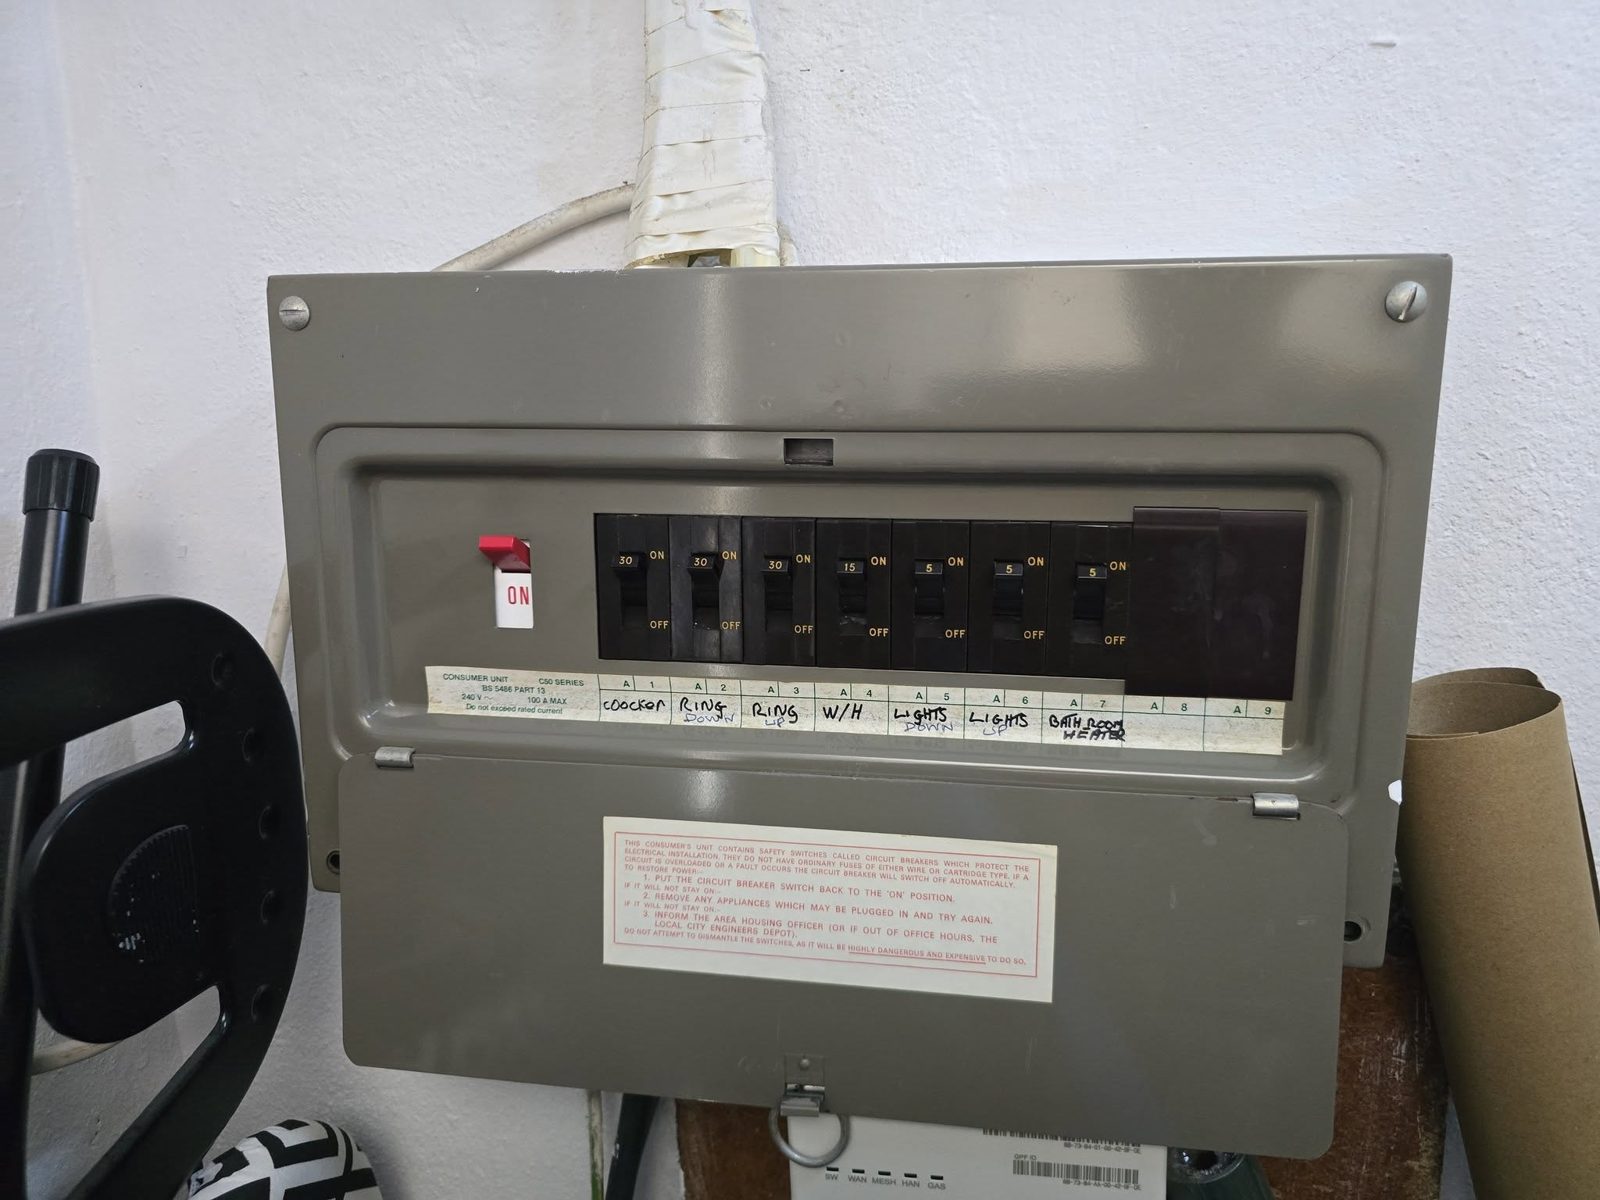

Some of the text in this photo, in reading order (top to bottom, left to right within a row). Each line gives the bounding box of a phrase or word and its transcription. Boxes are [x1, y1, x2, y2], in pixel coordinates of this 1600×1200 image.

[619, 556, 632, 564] 30
[650, 550, 664, 560] ON
[722, 551, 737, 560] ON
[796, 554, 811, 563] ON
[694, 557, 708, 567] 30
[768, 560, 782, 570] 30
[871, 556, 886, 566] ON
[948, 557, 964, 566] ON
[1028, 557, 1044, 566] ON
[1110, 562, 1126, 570] ON
[844, 563, 856, 572] 15
[926, 564, 932, 572] 5
[1006, 565, 1012, 574] 5
[1090, 568, 1096, 577] 5
[508, 586, 529, 604] ON
[650, 620, 668, 629] OFF
[722, 621, 740, 630] OFF
[794, 625, 814, 634] OFF
[869, 628, 888, 637] OFF
[945, 630, 966, 638] OFF
[1024, 630, 1044, 640] OFF
[1105, 636, 1126, 645] OFF
[1022, 696, 1028, 704] 6
[680, 697, 726, 719] RING
[1150, 702, 1158, 710] A
[1233, 706, 1271, 715] A 9
[753, 703, 798, 723] RING
[823, 703, 862, 722] W/H
[894, 706, 947, 725] LIGHTS
[684, 713, 735, 723] DOWN
[766, 717, 785, 727] UP
[969, 712, 1028, 728] LIGHTS
[1049, 713, 1123, 730] BATH ROOM
[905, 722, 954, 732] DOWN
[983, 724, 1008, 736] UP
[1064, 728, 1126, 742] HEATER
[624, 847, 664, 856] ELECTRICAL
[797, 858, 835, 867] ORDINARY
[839, 861, 862, 869] FUSES
[878, 863, 903, 872] EITHER
[906, 865, 925, 873] WIRE
[942, 868, 986, 877] CARTRIDGE
[718, 845, 754, 854] CONTAINS
[759, 847, 785, 856] SAFETY
[790, 849, 827, 858] SWITCHES
[832, 852, 860, 860] CALLED
[865, 854, 895, 863] CIRCUIT
[900, 856, 938, 866] BREAKERS
[943, 859, 969, 868] WHICH
[975, 861, 1009, 870] PROTECT
[624, 855, 652, 863] CIRCUIT
[664, 858, 711, 867] OVERLOADED
[735, 862, 757, 870] FAULT
[760, 864, 791, 873] OCCURS
[810, 867, 841, 876] CIRCUIT
[842, 870, 876, 878] BREAKER
[898, 873, 929, 882] SWITCH
[654, 874, 671, 882] PUT
[676, 875, 691, 884] THE
[696, 876, 730, 886] CIRCUIT
[736, 879, 774, 889] BREAKER
[780, 882, 814, 892] SWITCH
[819, 885, 842, 894] BACK
[848, 887, 859, 895] TO
[865, 888, 881, 897] THE
[654, 892, 689, 902] REMOVE
[694, 894, 712, 903] ANY
[716, 896, 770, 908] APPLIANCES
[774, 900, 804, 910] WHICH
[810, 903, 830, 912] MAY
[835, 905, 846, 913] BE
[851, 906, 893, 916] PLUGGED
[898, 909, 908, 918] IN
[913, 910, 933, 919] AND
[938, 912, 956, 921] TRY
[654, 910, 688, 920] INFORM
[693, 913, 709, 921] THE
[713, 914, 736, 924] AREA
[741, 916, 782, 927] HOUSING
[786, 920, 823, 930] OFFICER
[850, 924, 857, 933] IF
[862, 925, 881, 934] OUT
[886, 927, 898, 936] OF
[903, 928, 934, 938] OFFICE
[980, 934, 997, 943] THE
[654, 919, 682, 929] LOCAL
[686, 921, 705, 930] CITY
[710, 923, 758, 934] ENGINEERS
[848, 1175, 866, 1183] WAN
[872, 1178, 896, 1186] MESH
[902, 1180, 920, 1188] HAN
[928, 1182, 946, 1190] GAS
